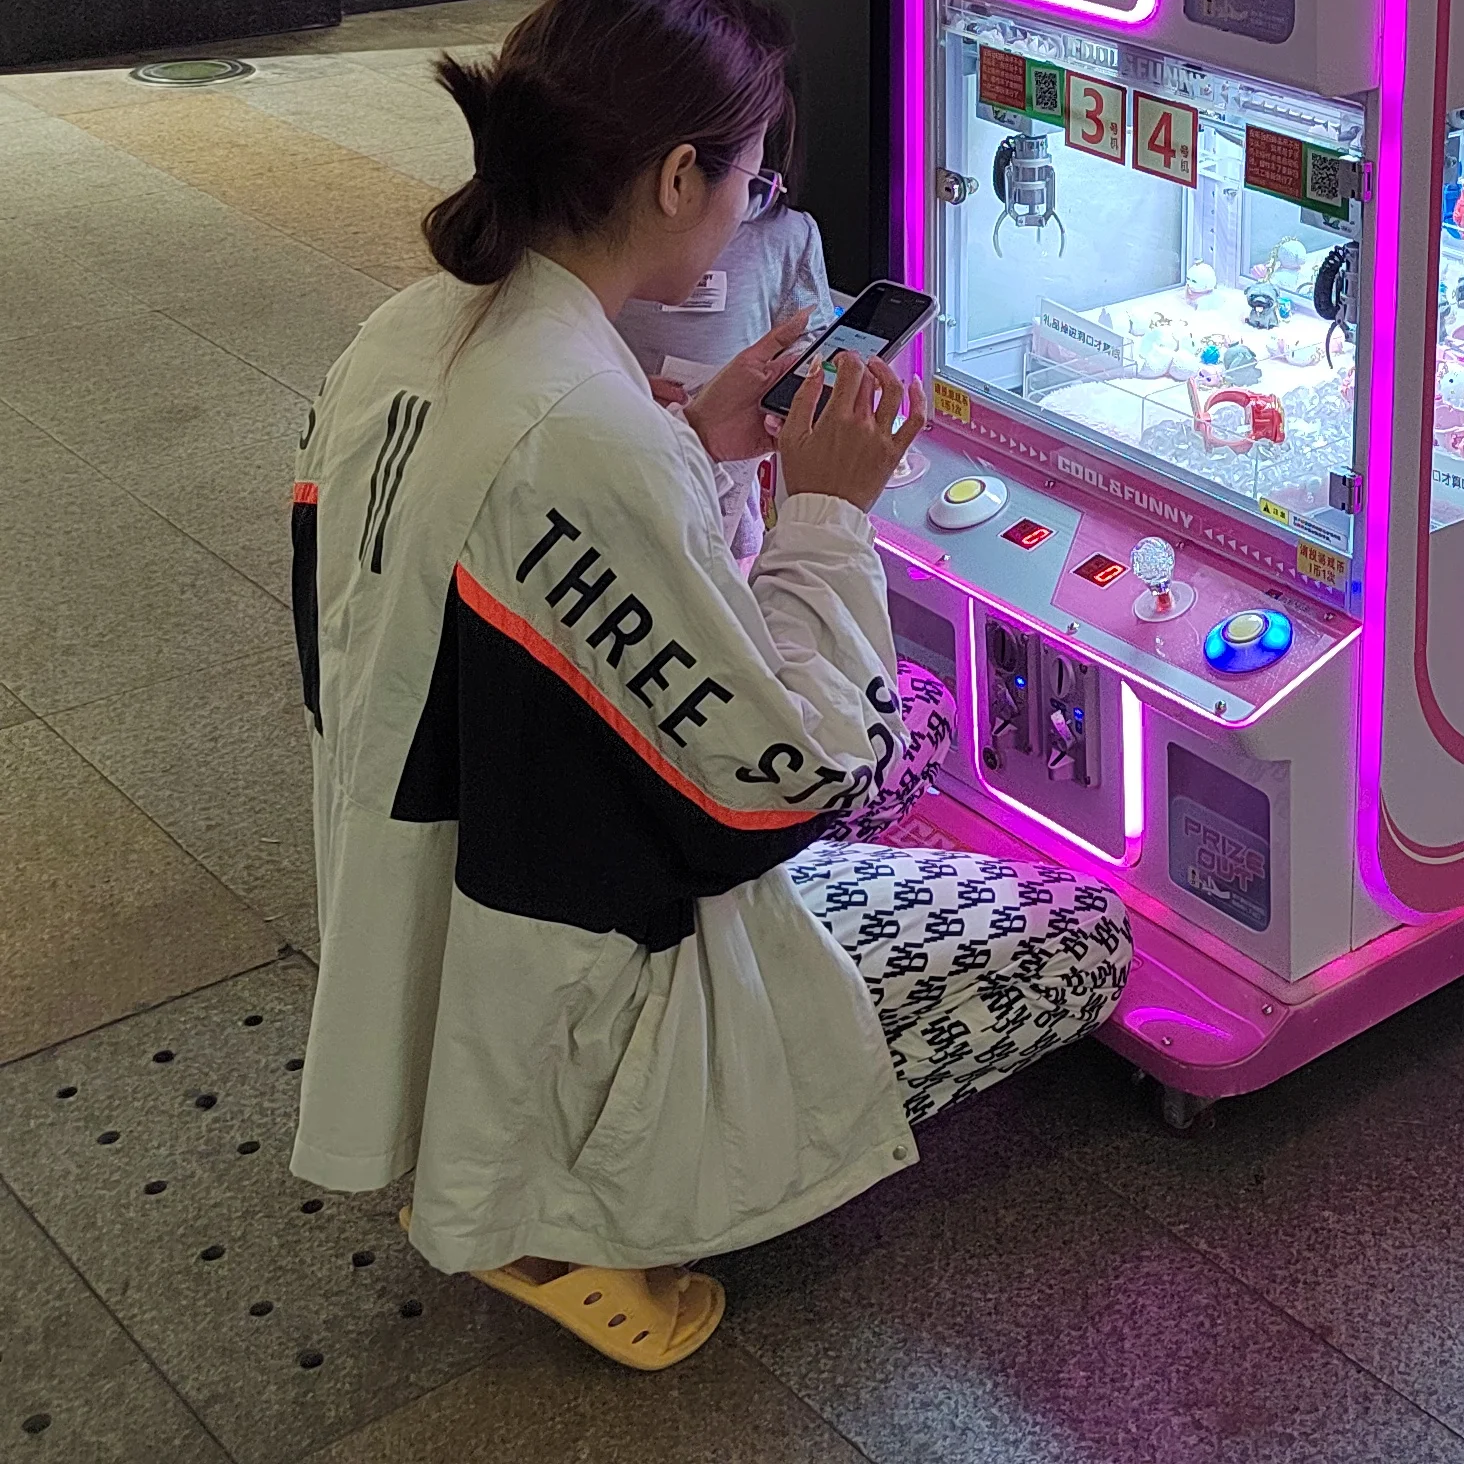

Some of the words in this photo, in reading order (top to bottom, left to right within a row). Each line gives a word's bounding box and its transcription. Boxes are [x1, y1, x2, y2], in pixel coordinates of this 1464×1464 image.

[1081, 87, 1105, 145] 3
[1147, 111, 1177, 170] 4
[1057, 454, 1194, 530] COOL&FUNNY
[515, 507, 735, 749] THREE
[1184, 815, 1266, 880] PRIZE
[1197, 847, 1254, 892] OUT
